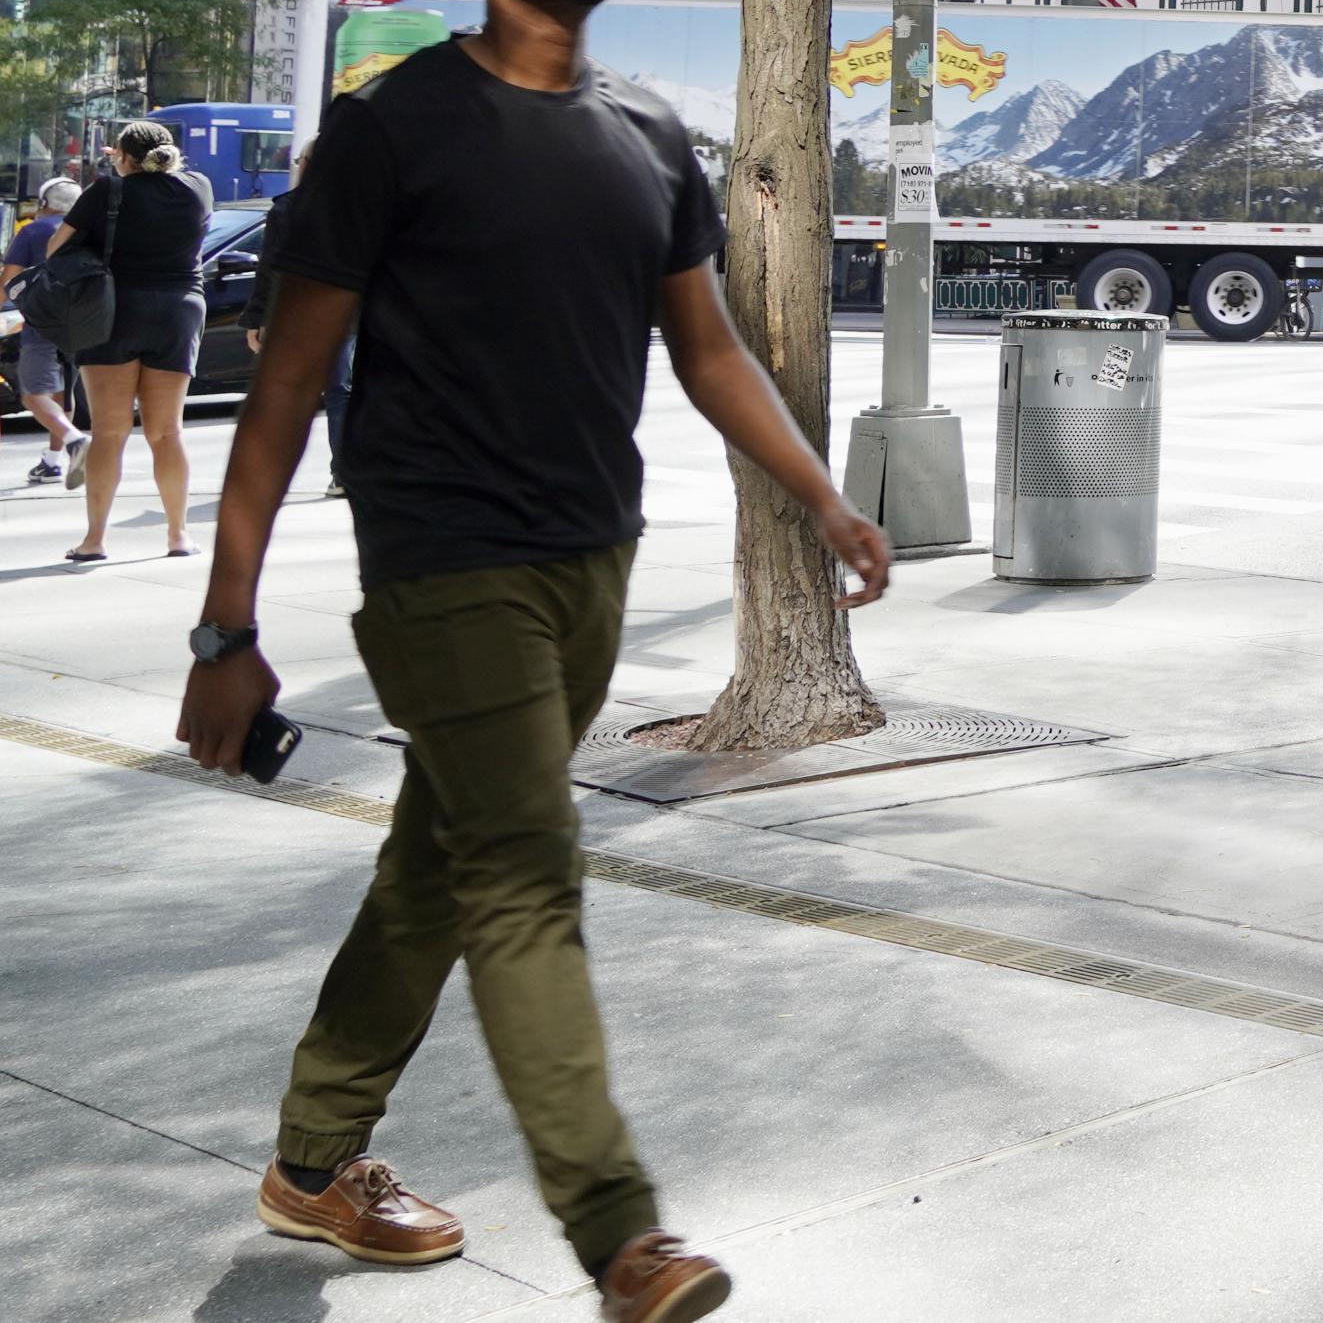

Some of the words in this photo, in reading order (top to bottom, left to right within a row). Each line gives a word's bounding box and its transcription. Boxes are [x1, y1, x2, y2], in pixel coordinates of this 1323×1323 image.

[849, 49, 893, 71] SIER
[937, 52, 979, 75] VADA
[901, 165, 932, 178] MOVIN
[900, 189, 925, 204] $30
